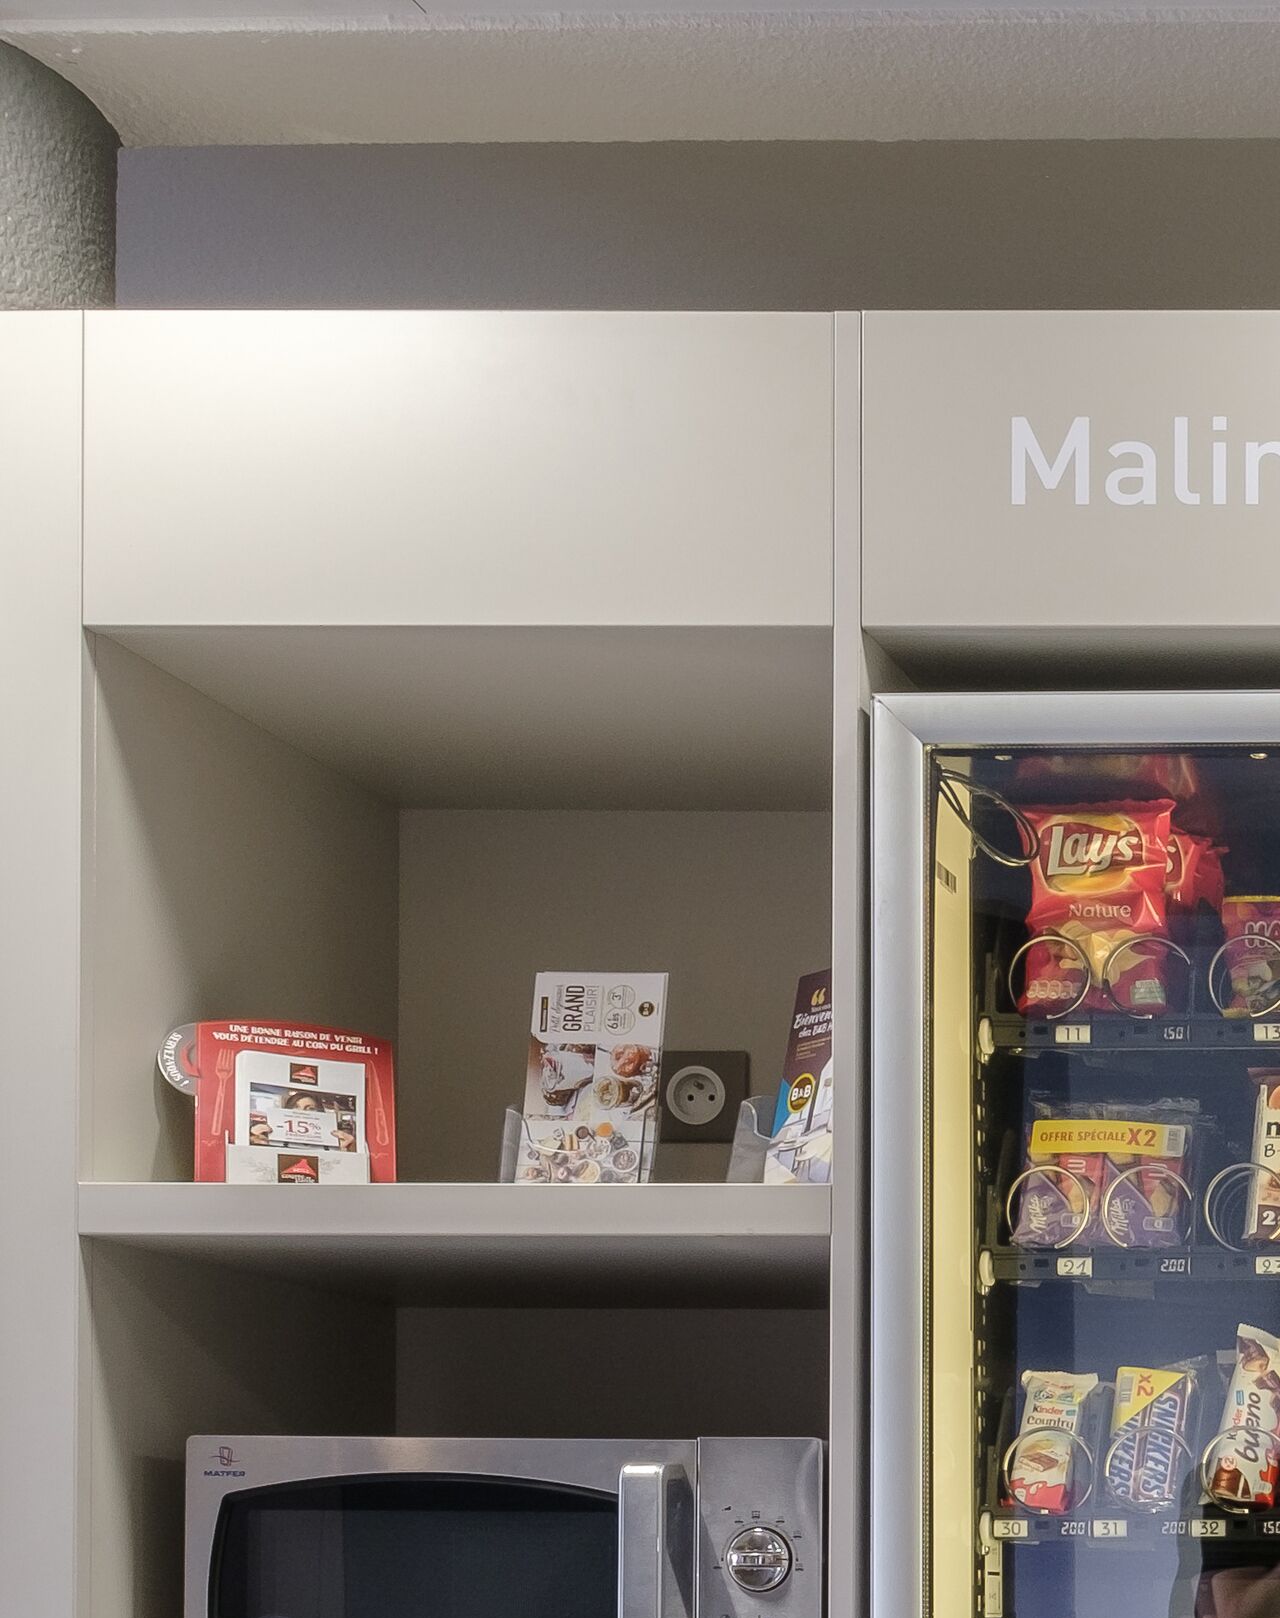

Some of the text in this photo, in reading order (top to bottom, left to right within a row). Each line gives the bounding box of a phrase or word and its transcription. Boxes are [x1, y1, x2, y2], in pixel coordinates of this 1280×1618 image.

[1047, 825, 1141, 877] Lay's
[1068, 902, 1132, 919] Nature
[562, 985, 585, 1032] GRAND
[229, 1024, 248, 1033] UNE
[251, 1025, 283, 1038] BONNE
[284, 1028, 317, 1041] RAISON
[319, 1032, 331, 1041] DE
[1064, 1026, 1082, 1041] 11
[212, 1031, 239, 1042] VOUS
[291, 1039, 304, 1048] AU
[305, 1040, 328, 1051] COIN
[329, 1042, 343, 1052] DU
[345, 1044, 372, 1055] GRILL
[1039, 1130, 1074, 1142] OFFRE
[1077, 1128, 1127, 1142] SPÉCIALE
[1261, 1212, 1277, 1227] 2
[1063, 1260, 1087, 1275] 21
[1027, 1415, 1074, 1431] Country
[1001, 1522, 1022, 1535] 30
[1101, 1522, 1119, 1535] 31
[1199, 1522, 1219, 1535] 32
